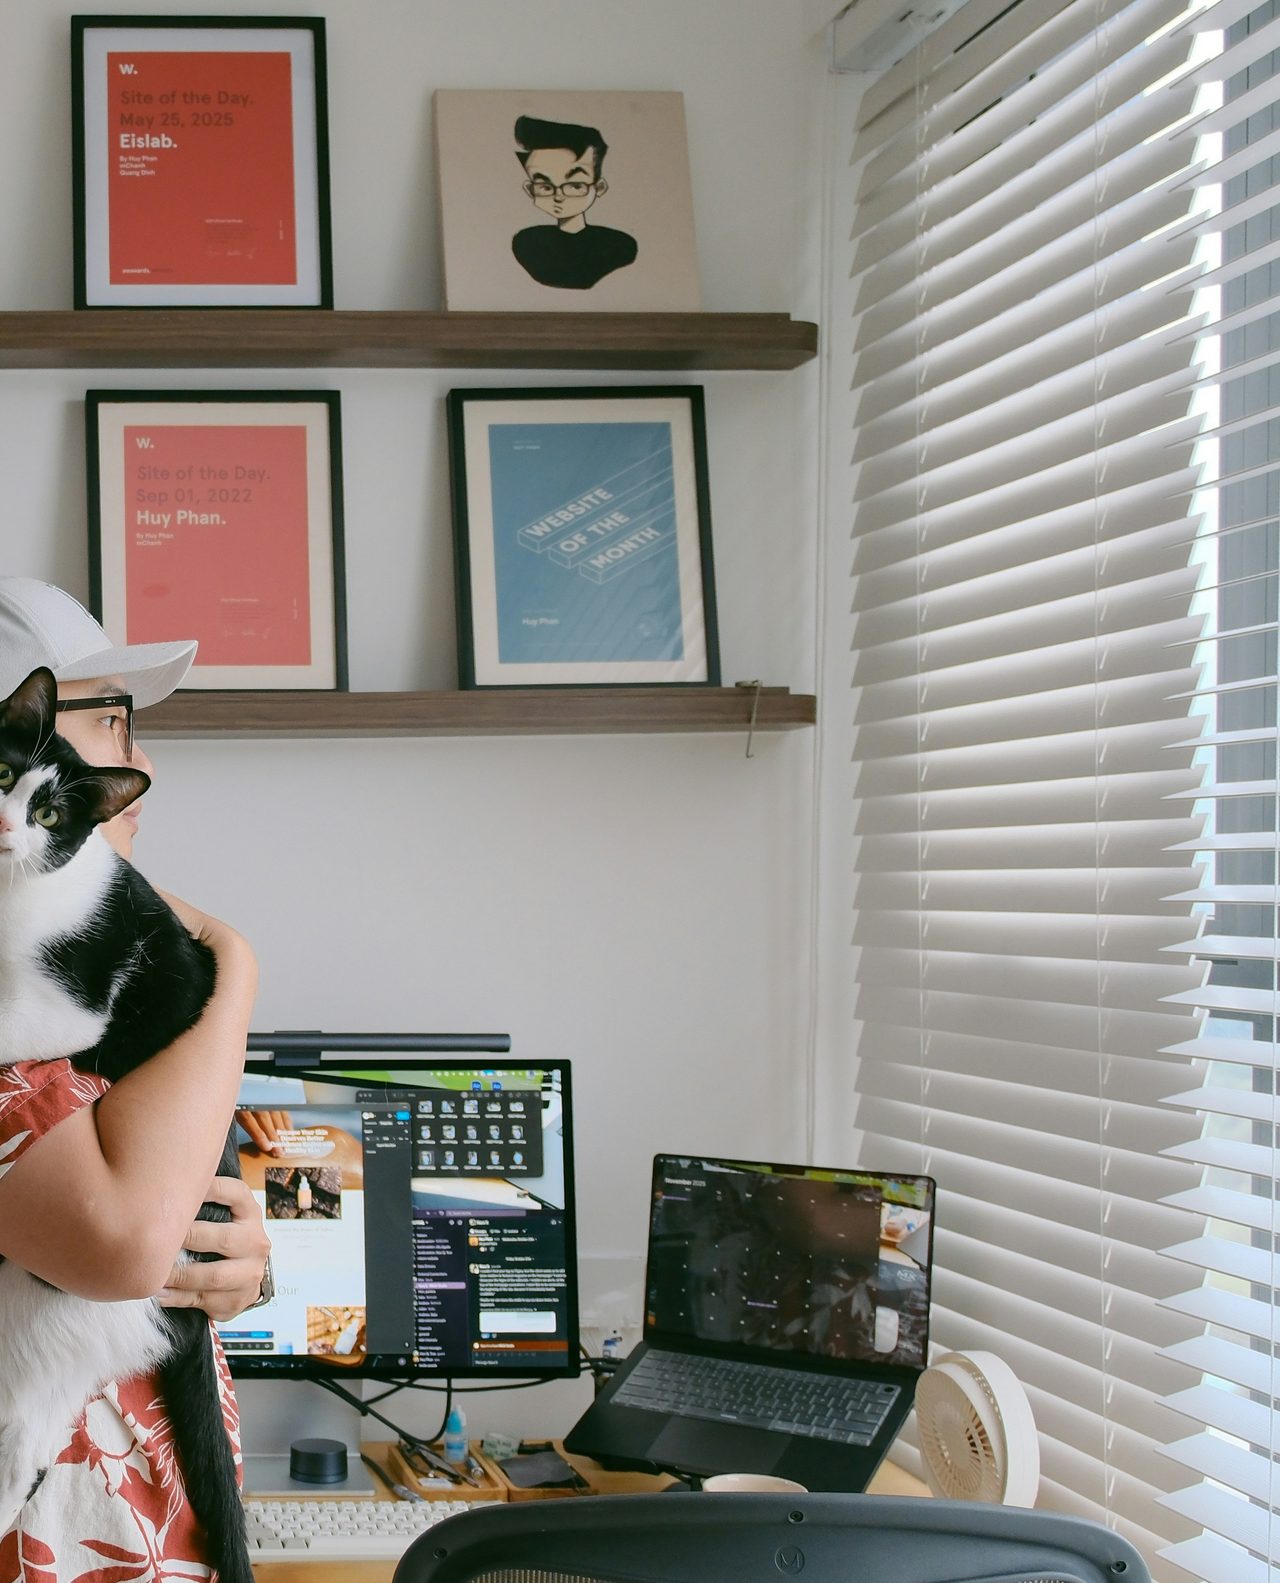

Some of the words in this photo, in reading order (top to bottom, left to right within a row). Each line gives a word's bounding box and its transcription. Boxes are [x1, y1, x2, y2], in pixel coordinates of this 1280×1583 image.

[120, 90, 153, 105] Site
[159, 90, 177, 105] of
[182, 90, 211, 105] the
[218, 90, 255, 108] Day.
[120, 112, 154, 129] May
[160, 112, 185, 128] 25,
[191, 112, 234, 127] 2025
[120, 133, 178, 148] Eislab.
[136, 438, 154, 449] w.
[137, 466, 170, 480] Site
[176, 466, 194, 480] of
[199, 466, 228, 480] the
[235, 466, 271, 484] Day.
[136, 488, 168, 506] Sep
[175, 488, 200, 505] 01,
[207, 488, 254, 503] 2022
[136, 510, 172, 528] Huy
[176, 510, 227, 525] Phan.
[525, 488, 614, 537] WEBSITE
[559, 533, 589, 552] OF
[587, 512, 631, 536] THE
[589, 527, 662, 569] MONTH
[522, 618, 538, 626] Huy
[664, 1177, 692, 1186] November
[278, 1286, 299, 1296] Our
